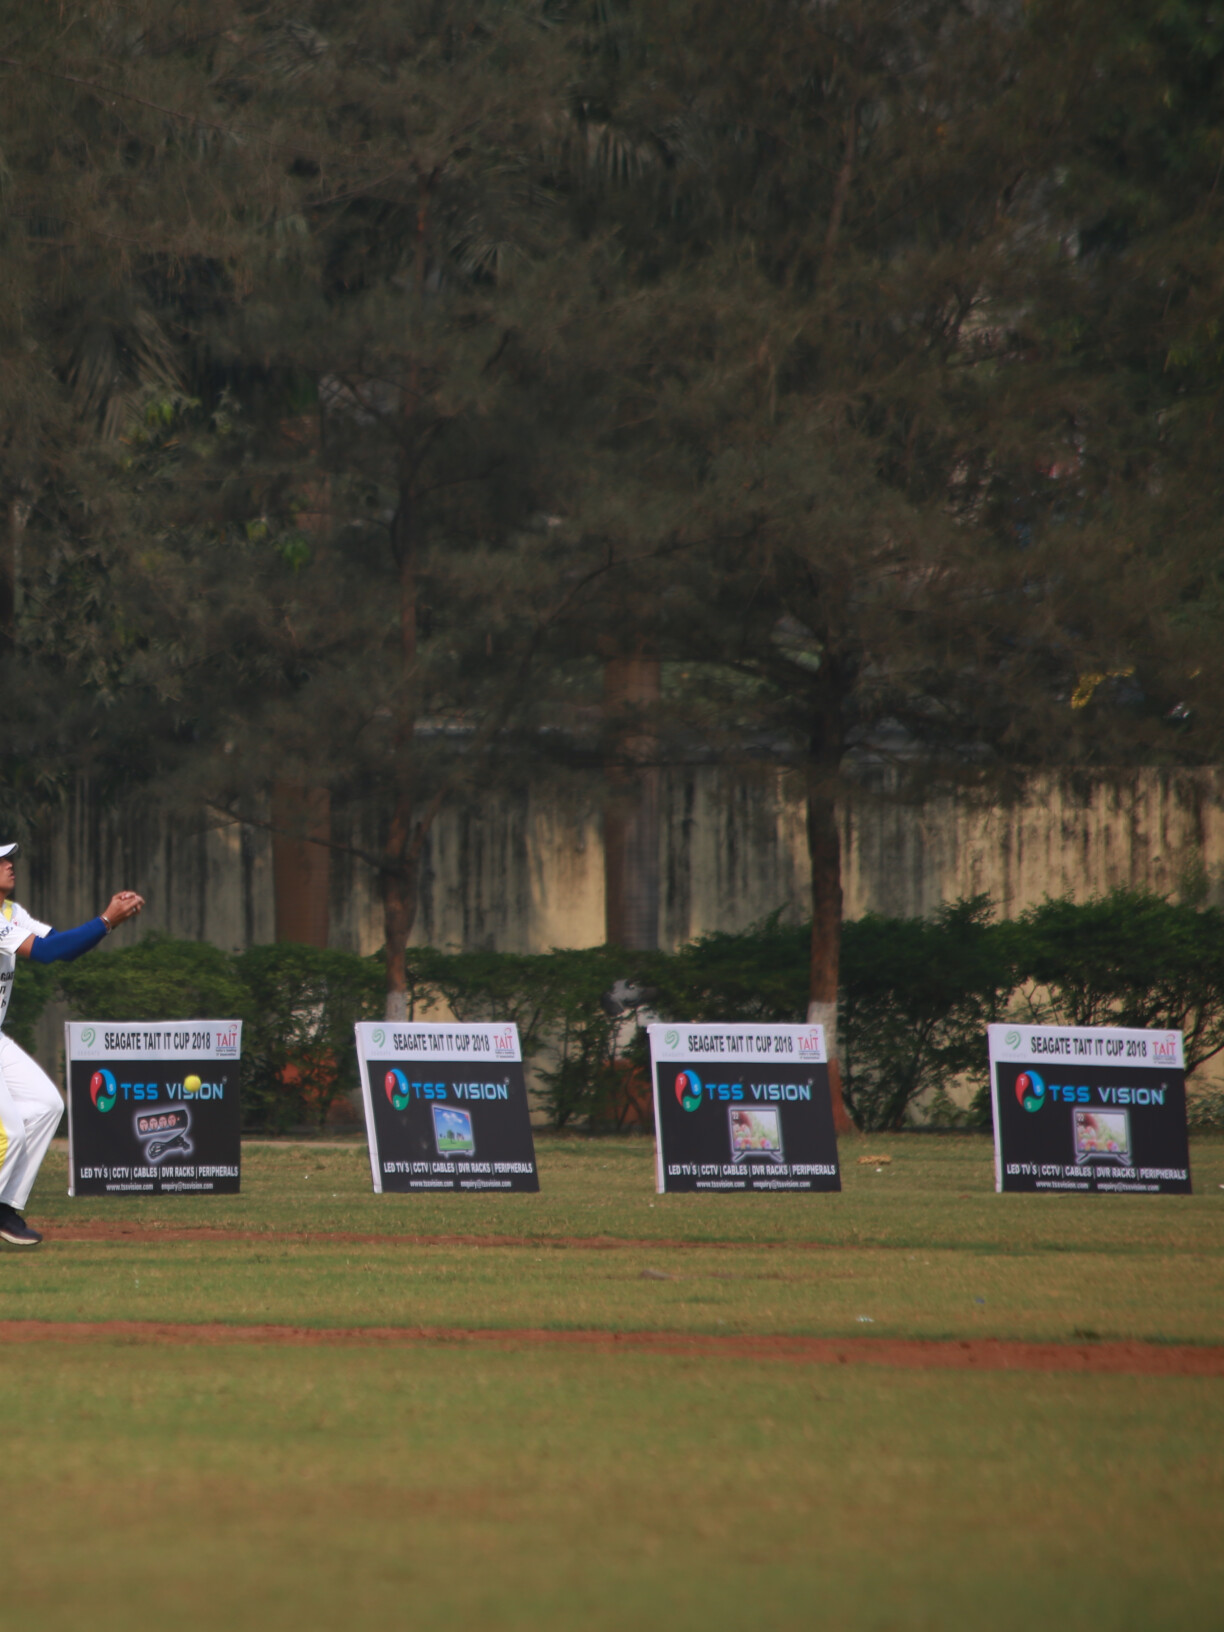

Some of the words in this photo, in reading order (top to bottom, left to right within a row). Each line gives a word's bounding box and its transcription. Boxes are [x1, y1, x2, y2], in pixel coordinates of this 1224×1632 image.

[105, 1032, 141, 1050] SEAGATE
[144, 1032, 161, 1049] TAIT
[164, 1033, 171, 1049] IT
[174, 1032, 189, 1049] CUP
[192, 1032, 210, 1050] 2018
[216, 1033, 237, 1047] TAIT
[394, 1034, 426, 1051] SEAGATE
[428, 1034, 444, 1050] TAIT
[446, 1035, 453, 1050] IT
[455, 1035, 470, 1050] CUP
[473, 1035, 490, 1051] 2018
[494, 1036, 513, 1049] TAIT
[688, 1035, 724, 1052] SEAGATE
[726, 1036, 743, 1052] TAIT
[746, 1036, 753, 1051] IT
[756, 1036, 772, 1052] CUP
[775, 1036, 793, 1052] 2018
[798, 1037, 818, 1050] TAIT
[1031, 1037, 1071, 1054] SEAGATE
[1073, 1038, 1092, 1055] TAIT
[1095, 1039, 1103, 1055] IT
[1106, 1040, 1124, 1056] CUP
[1127, 1041, 1147, 1057] 2018
[1153, 1042, 1175, 1055] TAIT
[121, 1083, 158, 1099] TSS
[412, 1083, 447, 1099] TSS
[453, 1083, 508, 1099] VISION
[705, 1084, 744, 1100] TSS
[751, 1084, 810, 1100] VISION
[1049, 1086, 1090, 1102] TSS
[1098, 1087, 1164, 1105] VISION
[81, 1168, 92, 1178] LED
[94, 1165, 108, 1178] TV'S
[113, 1168, 129, 1178] CCTV
[134, 1168, 157, 1178] CABLES
[162, 1168, 174, 1177] DVR
[176, 1167, 194, 1177] RACKS
[199, 1166, 238, 1177] PERIPHERALS
[384, 1163, 395, 1173] LED
[396, 1161, 410, 1173] TV'S
[413, 1163, 428, 1172] CCTV
[433, 1163, 454, 1172] CABLES
[458, 1163, 470, 1172] DVR
[471, 1163, 490, 1172] RACKS
[494, 1163, 532, 1173] PERIPHERALS
[669, 1165, 680, 1175] LED
[682, 1163, 697, 1175] TV'S
[701, 1165, 718, 1174] CCTV
[723, 1165, 748, 1174] CABLES
[752, 1165, 765, 1175] DVR
[766, 1165, 788, 1175] RACKS
[792, 1165, 835, 1175] PERIPHERALS
[1007, 1165, 1020, 1174] LED
[1021, 1162, 1036, 1175] TV'S
[1042, 1166, 1060, 1176] CCTV
[1065, 1167, 1091, 1177] CABLES
[1097, 1168, 1111, 1177] DVR
[1112, 1168, 1135, 1178] RACKS
[1140, 1168, 1186, 1179] PERIPHERALS
